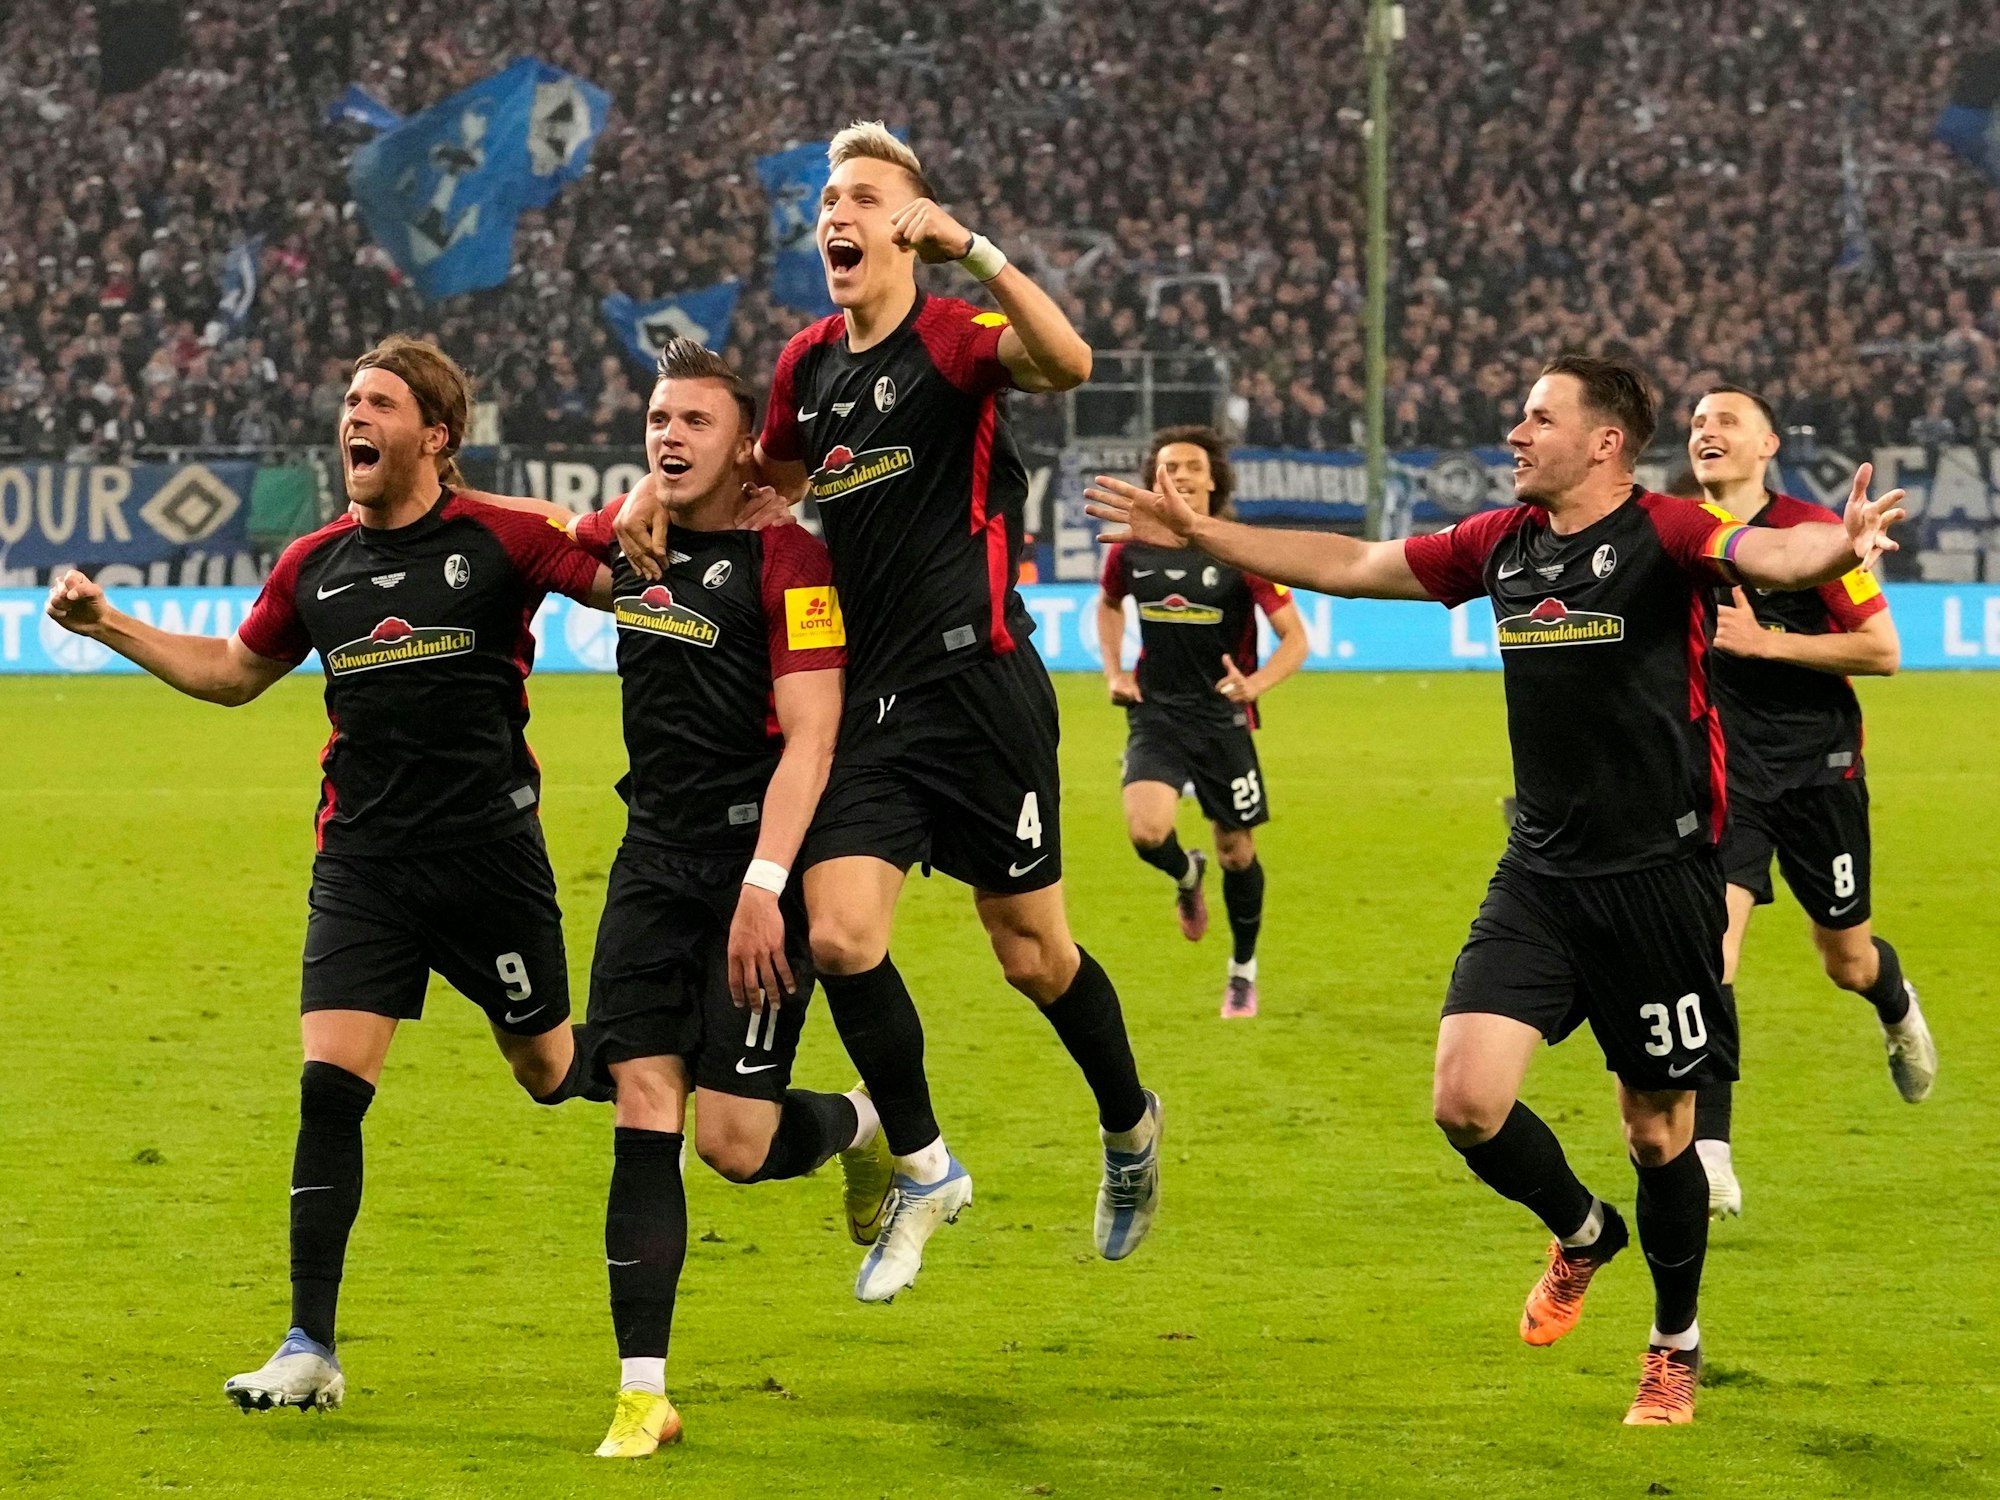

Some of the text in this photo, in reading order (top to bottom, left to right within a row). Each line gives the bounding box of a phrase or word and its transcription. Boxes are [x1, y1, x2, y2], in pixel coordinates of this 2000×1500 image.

[800, 618, 833, 630] LOTTO
[331, 633, 471, 670] Schwarzwaldmilch
[1231, 769, 1261, 811] 25
[1016, 792, 1043, 849] 4
[1833, 852, 1856, 898] 8
[496, 951, 532, 1001] 9
[1640, 993, 1708, 1057] 30
